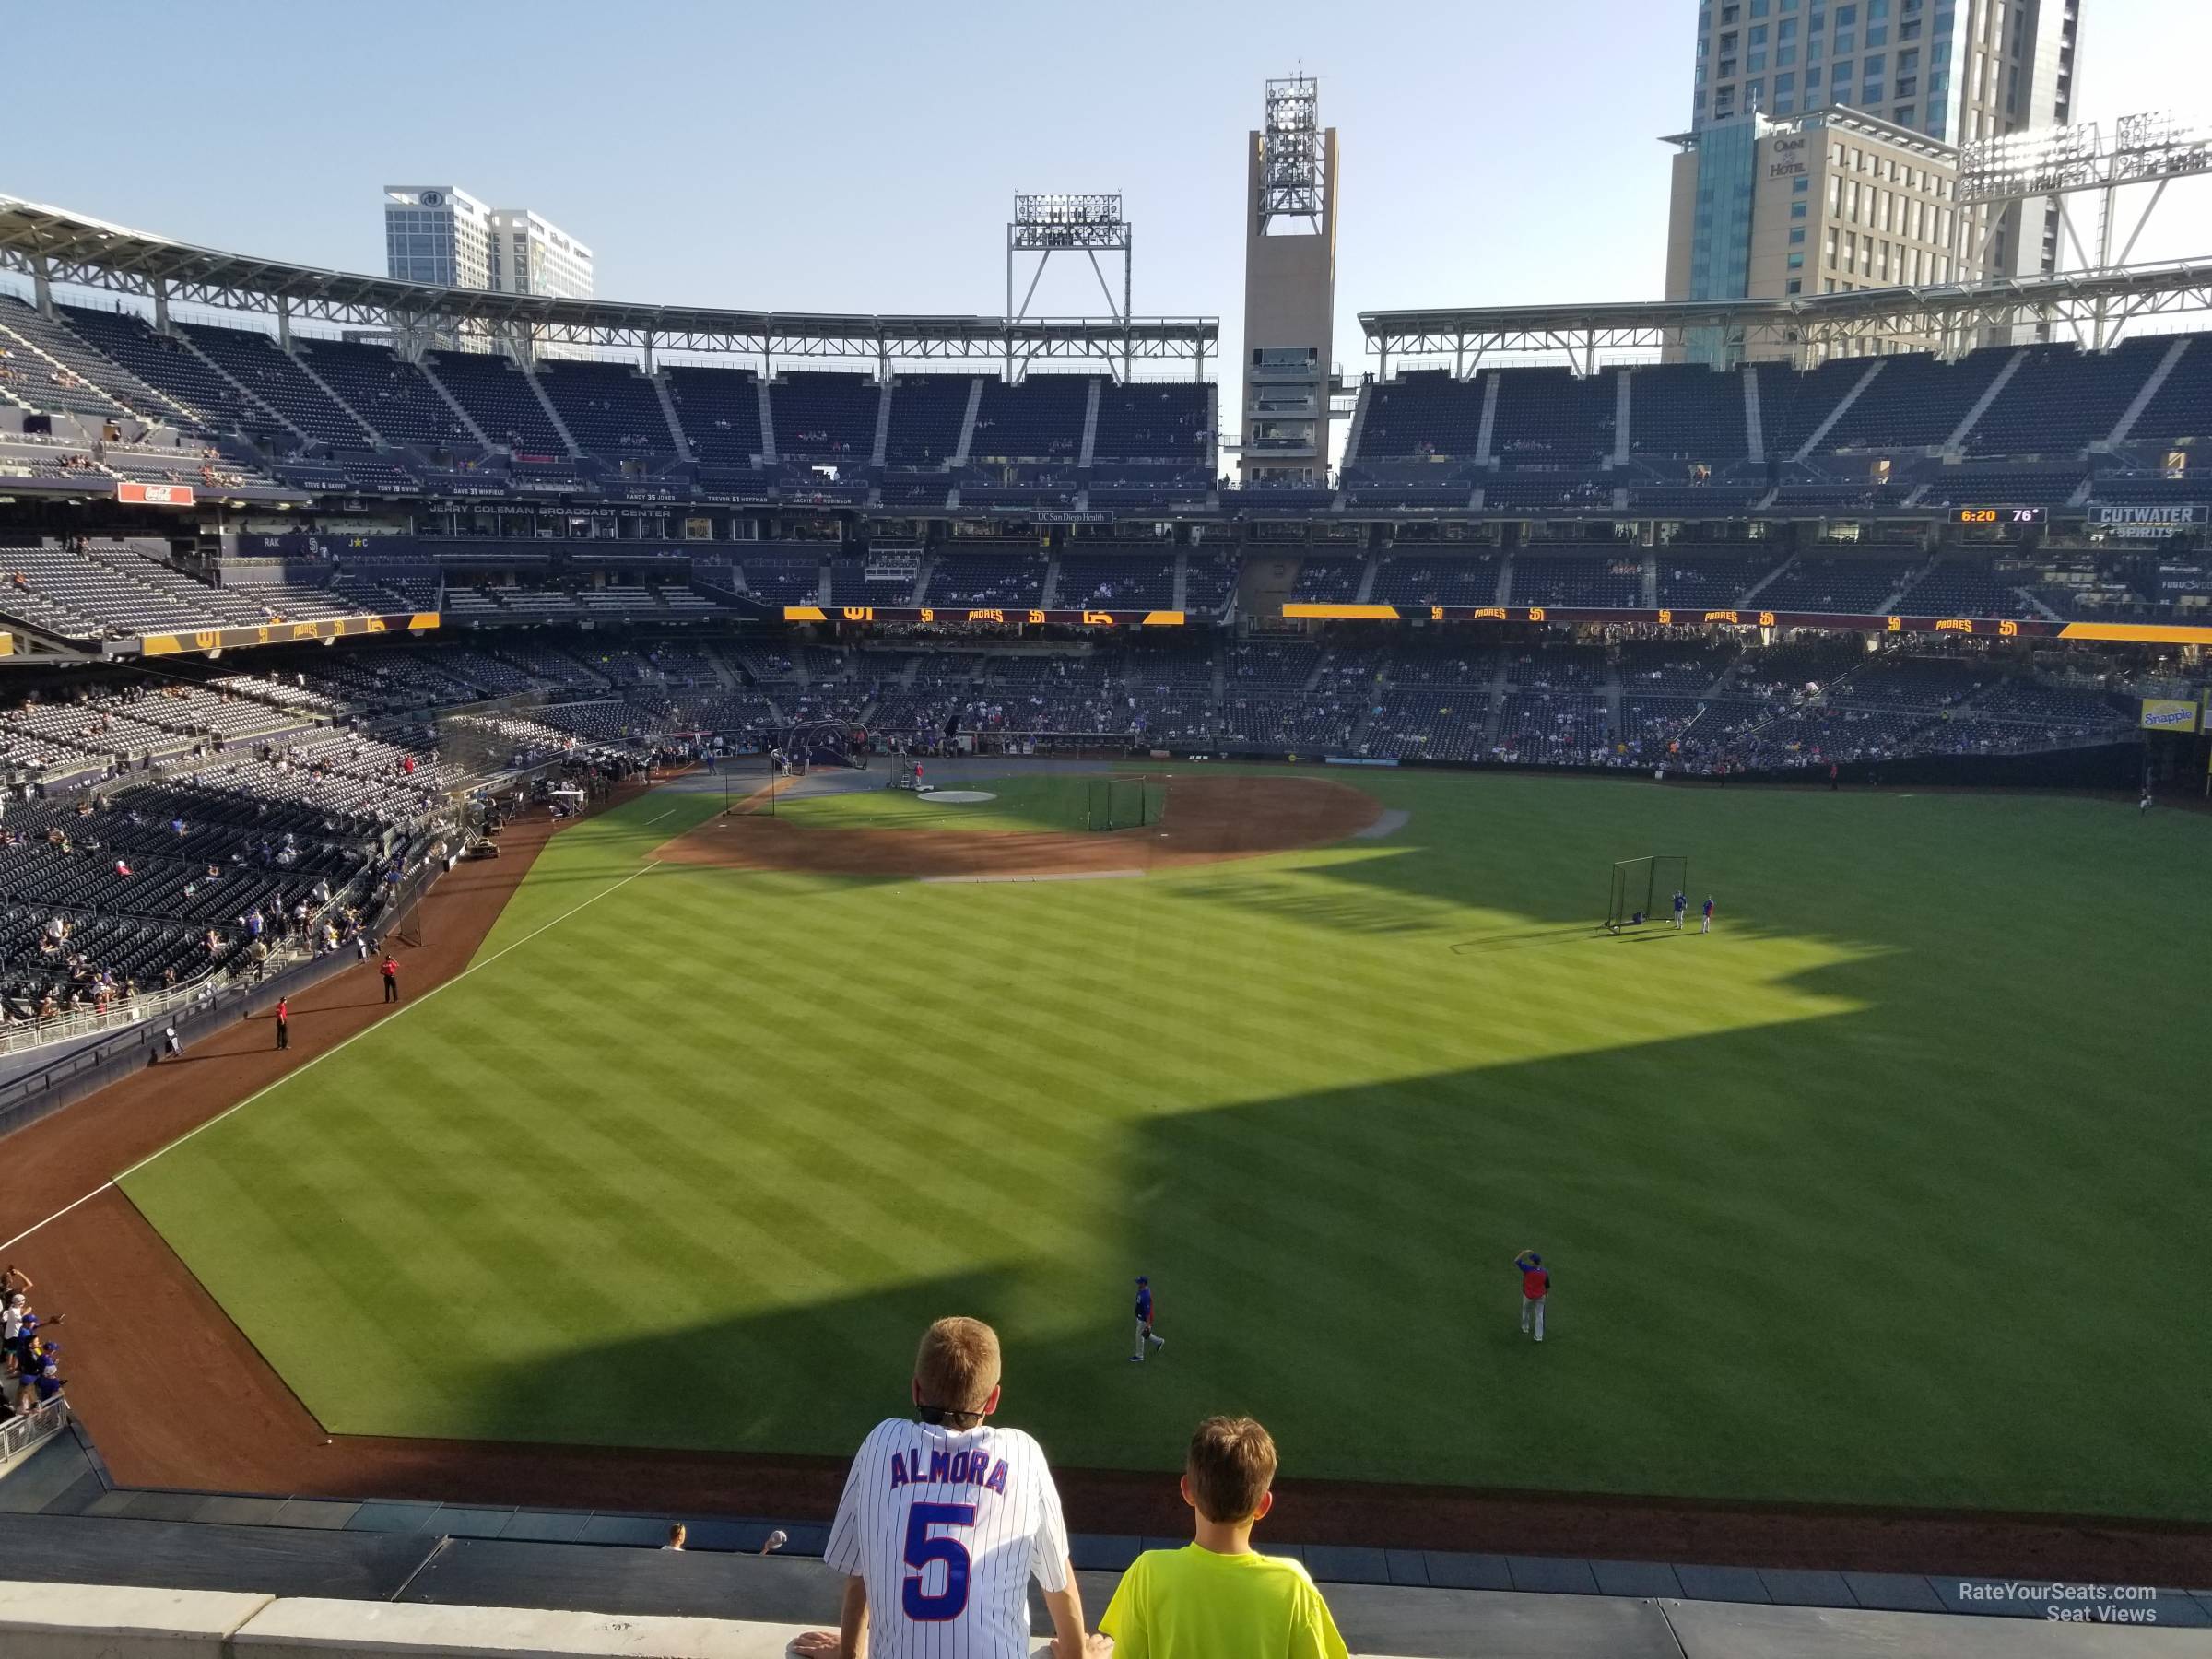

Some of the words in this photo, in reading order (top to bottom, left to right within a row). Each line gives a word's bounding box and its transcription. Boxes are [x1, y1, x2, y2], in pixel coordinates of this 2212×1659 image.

[474, 505, 534, 514] COLEMAN
[538, 508, 616, 516] BROADCAST
[621, 509, 671, 517] CENTER
[1960, 510, 1996, 522] 6:20
[2101, 508, 2193, 523] CUTWATER
[1038, 512, 1049, 522] UC
[1049, 512, 1063, 522] San
[1063, 512, 1083, 523] Diego
[1083, 512, 1104, 522] Health
[2117, 527, 2174, 538] SPIRITS
[264, 538, 279, 547] RAK
[2162, 581, 2185, 589] FUGU
[969, 609, 1004, 623] PADRES
[1474, 608, 1506, 619] PADRES
[1704, 611, 1737, 623] PADRES
[293, 622, 318, 639] PADRES
[1936, 619, 1972, 633] PADRES
[2145, 708, 2192, 725] Snapple
[890, 1447, 1010, 1495] ALMORA
[901, 1501, 977, 1622] 5
